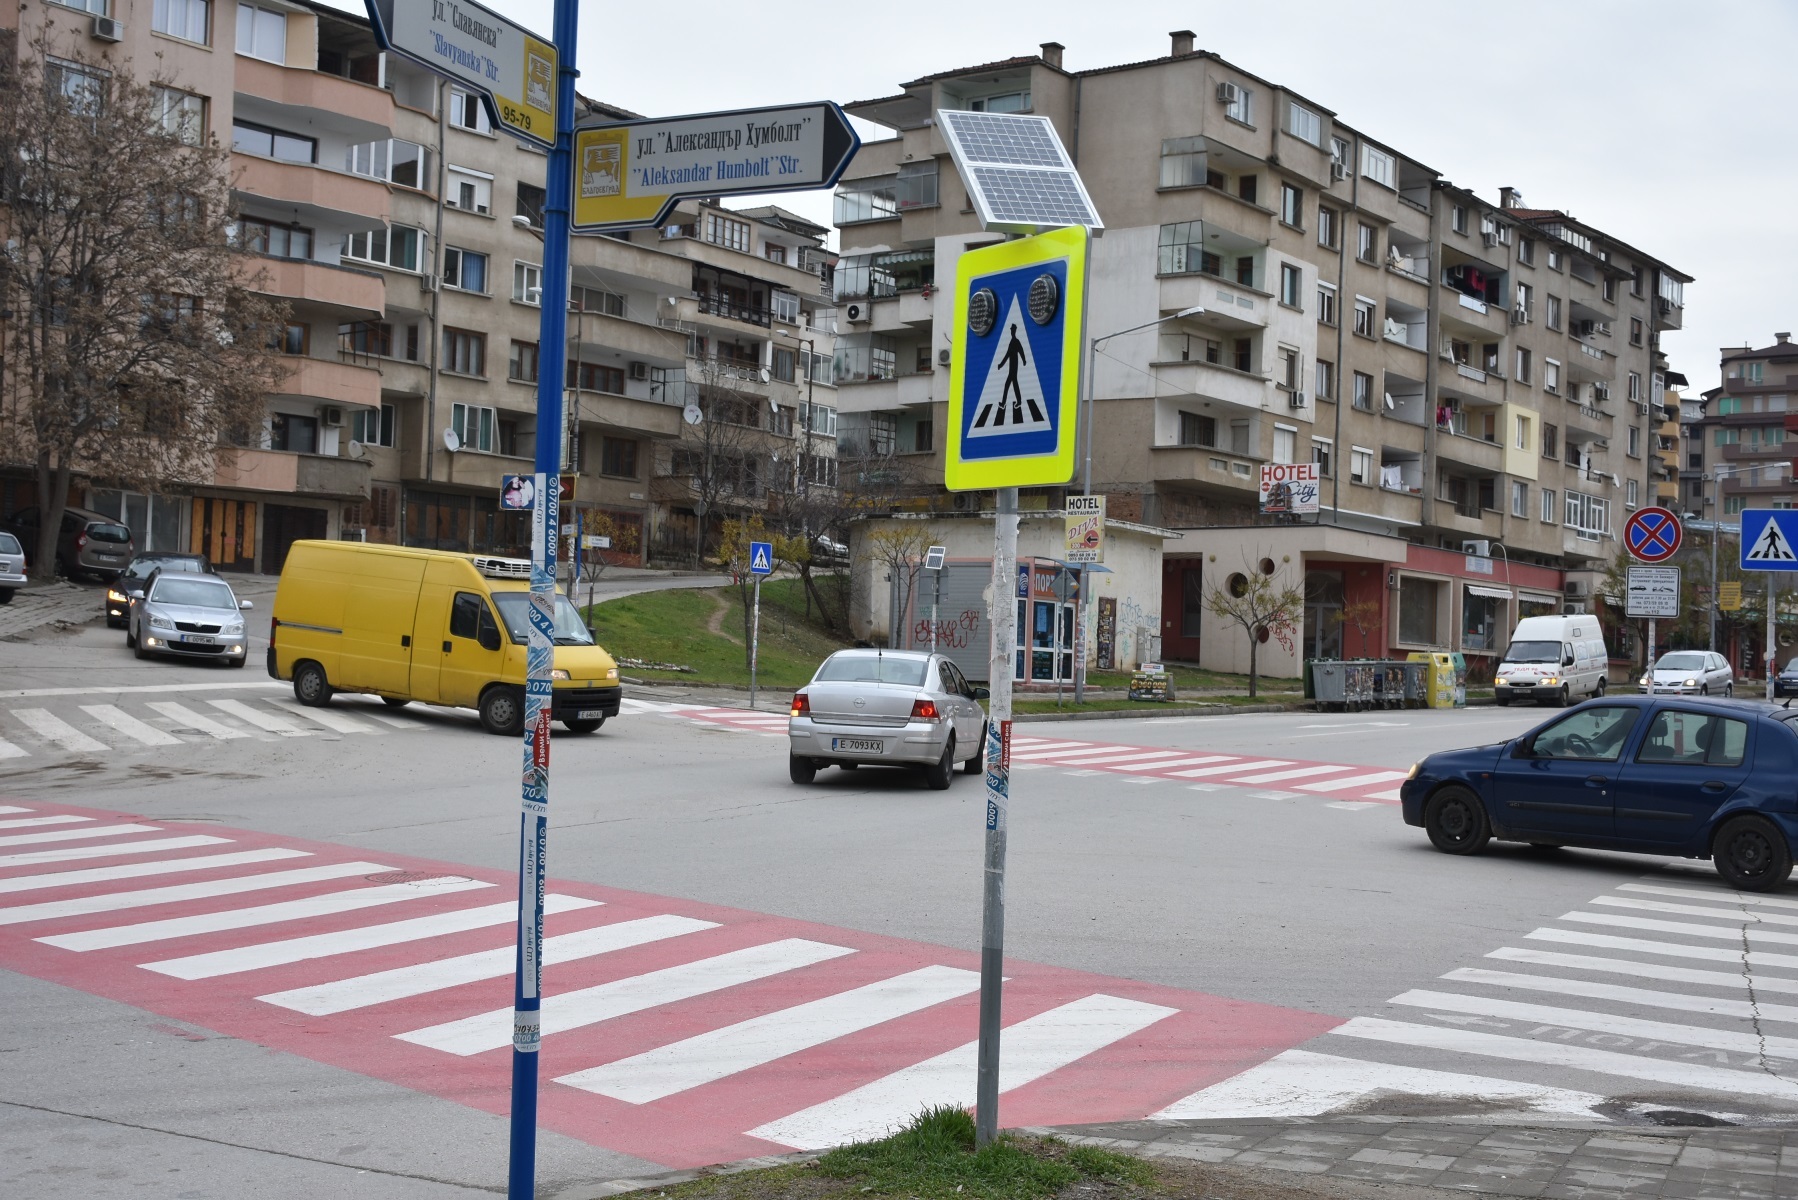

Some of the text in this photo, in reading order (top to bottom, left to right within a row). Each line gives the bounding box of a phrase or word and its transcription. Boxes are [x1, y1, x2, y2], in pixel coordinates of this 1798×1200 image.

[432, 0, 446, 22] ул.
[503, 106, 532, 130] 95-79
[636, 137, 656, 159] ул.
[1261, 464, 1318, 482] HOTEL
[1280, 480, 1318, 503] City
[1068, 497, 1100, 510] HOTEL
[547, 488, 558, 556] 0700 4 6000
[1068, 516, 1099, 541] DIVA
[840, 740, 846, 748] E
